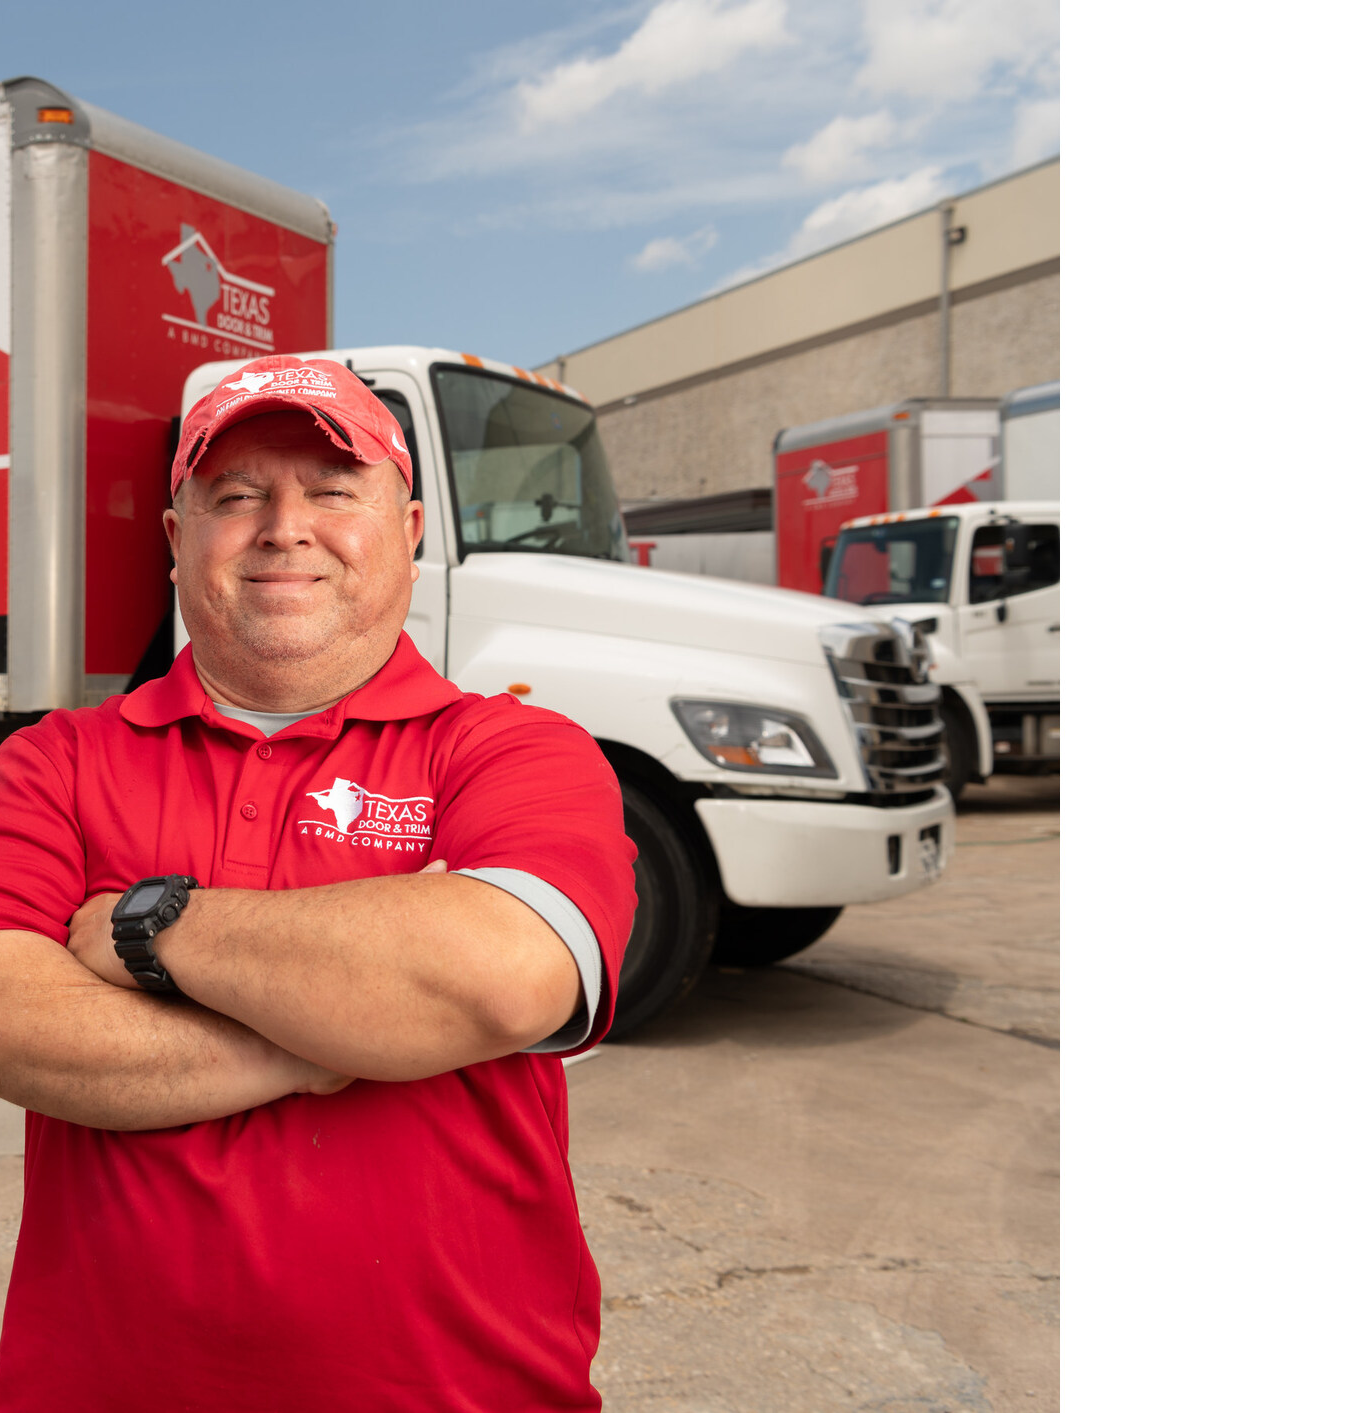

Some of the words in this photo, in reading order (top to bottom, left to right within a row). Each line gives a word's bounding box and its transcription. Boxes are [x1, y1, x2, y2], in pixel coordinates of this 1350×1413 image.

[221, 283, 270, 325] TEXAS
[167, 326, 176, 339] A
[271, 379, 300, 387] DOOR
[310, 379, 333, 387] TRIM
[276, 371, 328, 381] TEXAS
[298, 388, 336, 398] COMPANY
[364, 800, 426, 822] TEXAS
[358, 820, 391, 832] DOOR
[392, 824, 402, 833] &
[404, 824, 430, 835] TRIM
[301, 826, 308, 834] A
[315, 827, 344, 843] BMD
[351, 836, 425, 852] COMPANY
